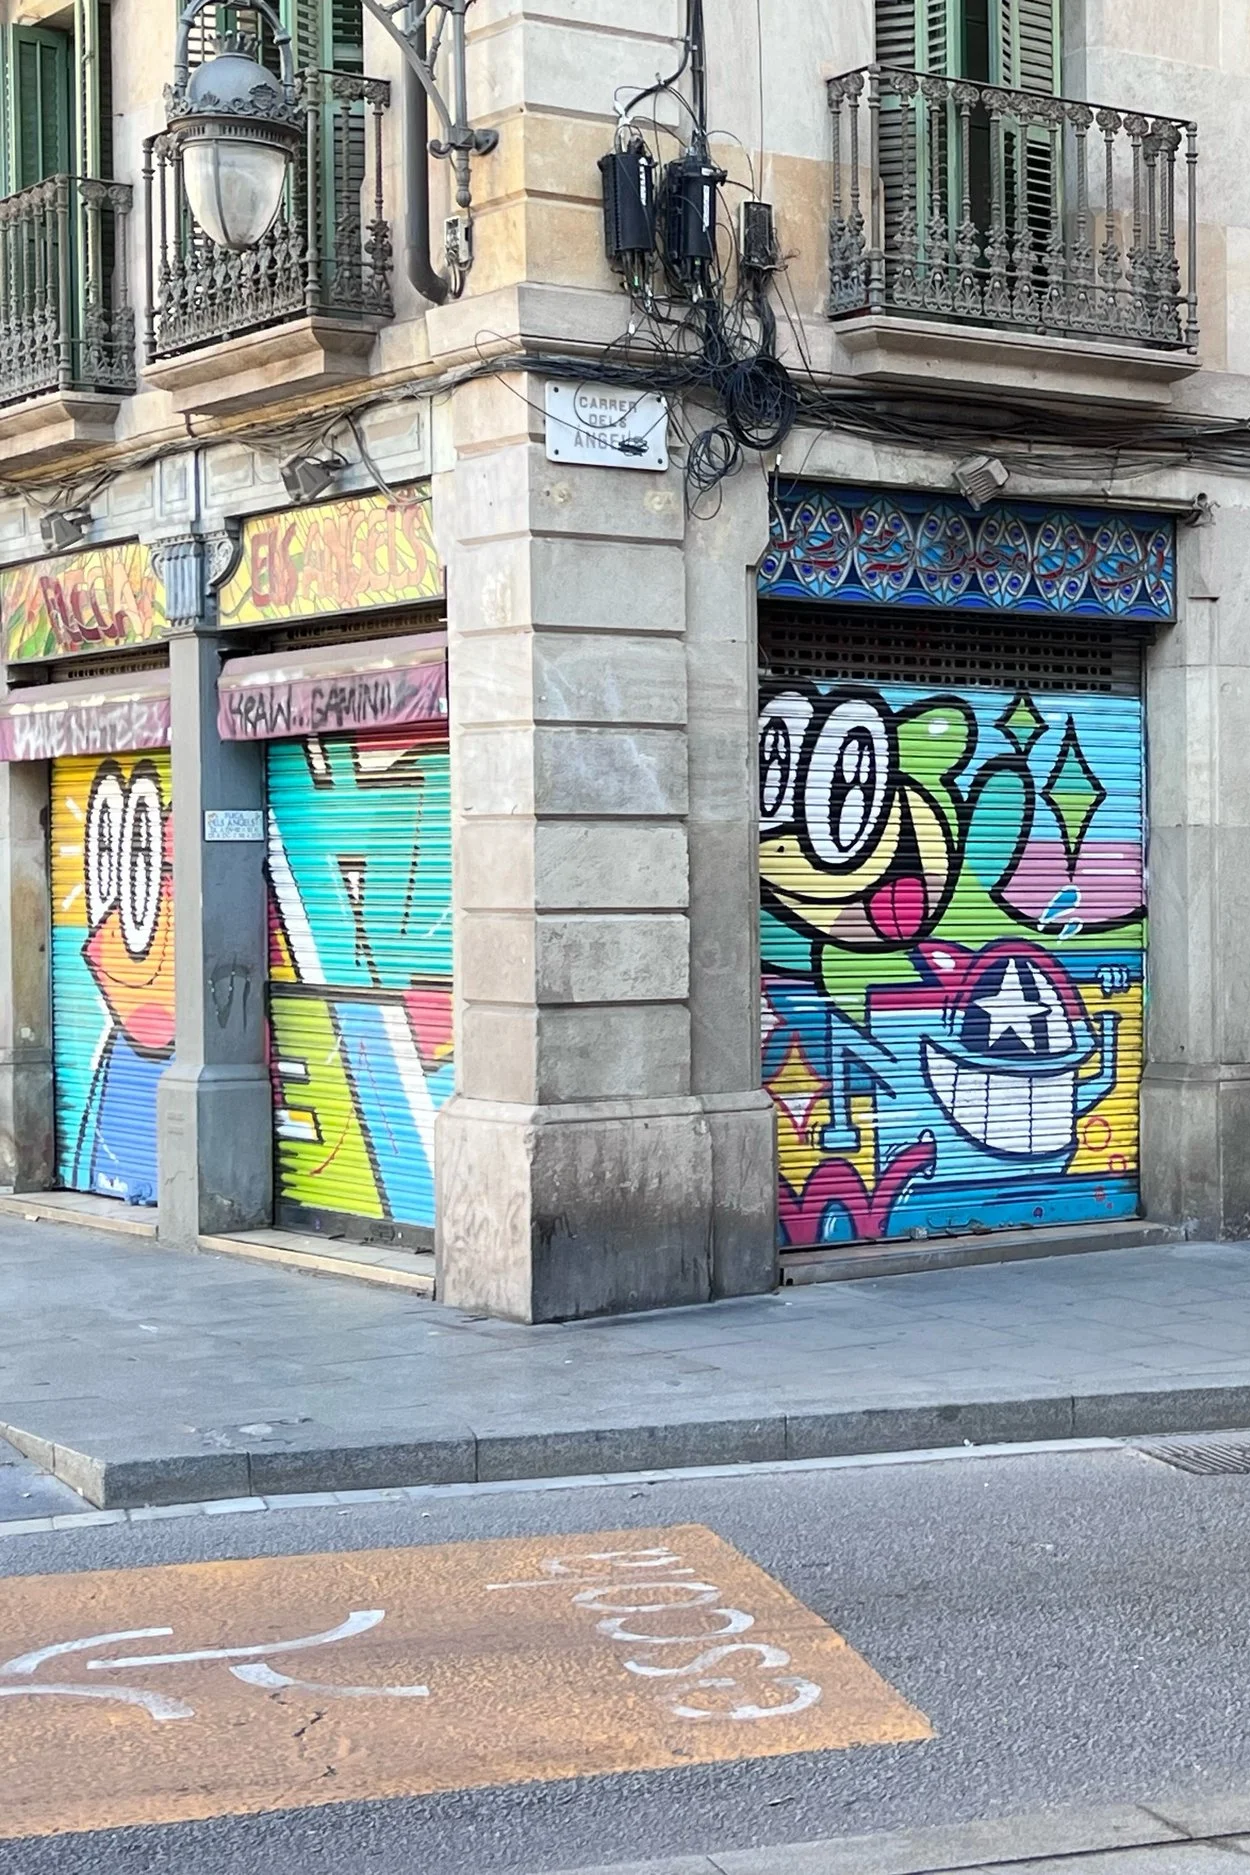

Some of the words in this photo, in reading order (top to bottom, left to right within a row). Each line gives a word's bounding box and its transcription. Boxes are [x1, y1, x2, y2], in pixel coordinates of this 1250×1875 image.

[579, 396, 637, 413] CARRER
[588, 413, 627, 428] DELS
[485, 1545, 825, 1723] escola
